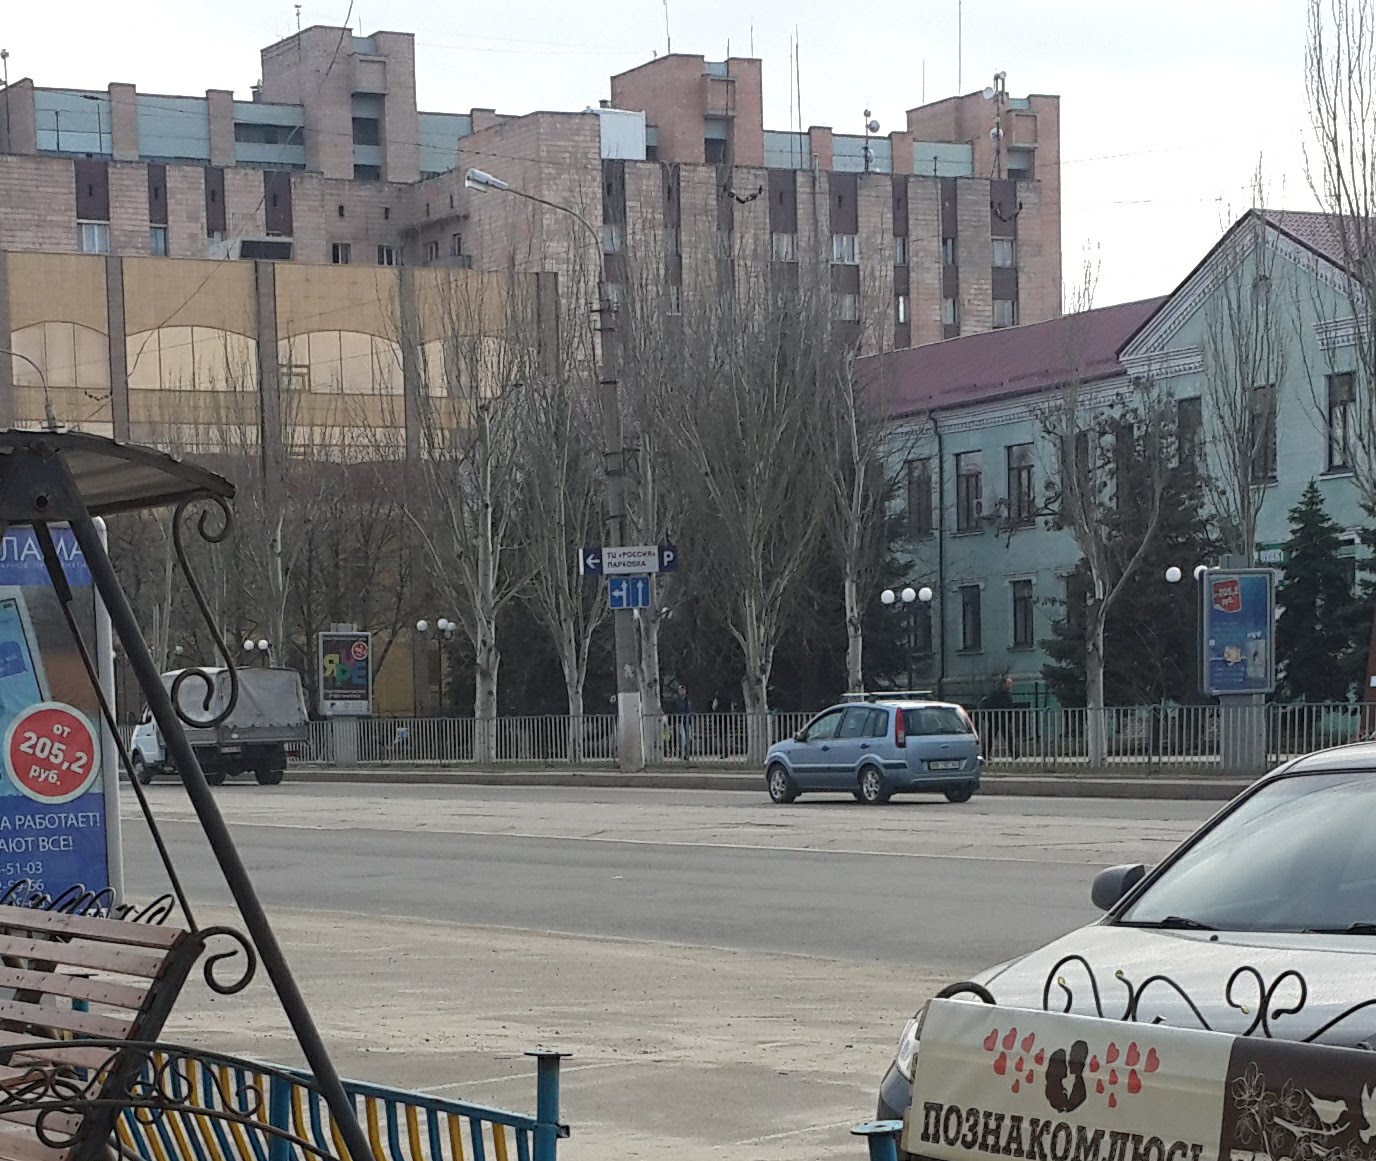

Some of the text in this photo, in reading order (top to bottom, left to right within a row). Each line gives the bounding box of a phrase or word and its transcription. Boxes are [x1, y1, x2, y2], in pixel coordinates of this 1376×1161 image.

[607, 560, 647, 568] ПАРКОВКА
[663, 550, 675, 567] P
[52, 723, 71, 738] от
[19, 730, 89, 775] 205,2
[28, 763, 62, 786] руб.
[15, 812, 100, 831] РАБОТАЕТ!
[38, 835, 74, 853] ВСЕ!
